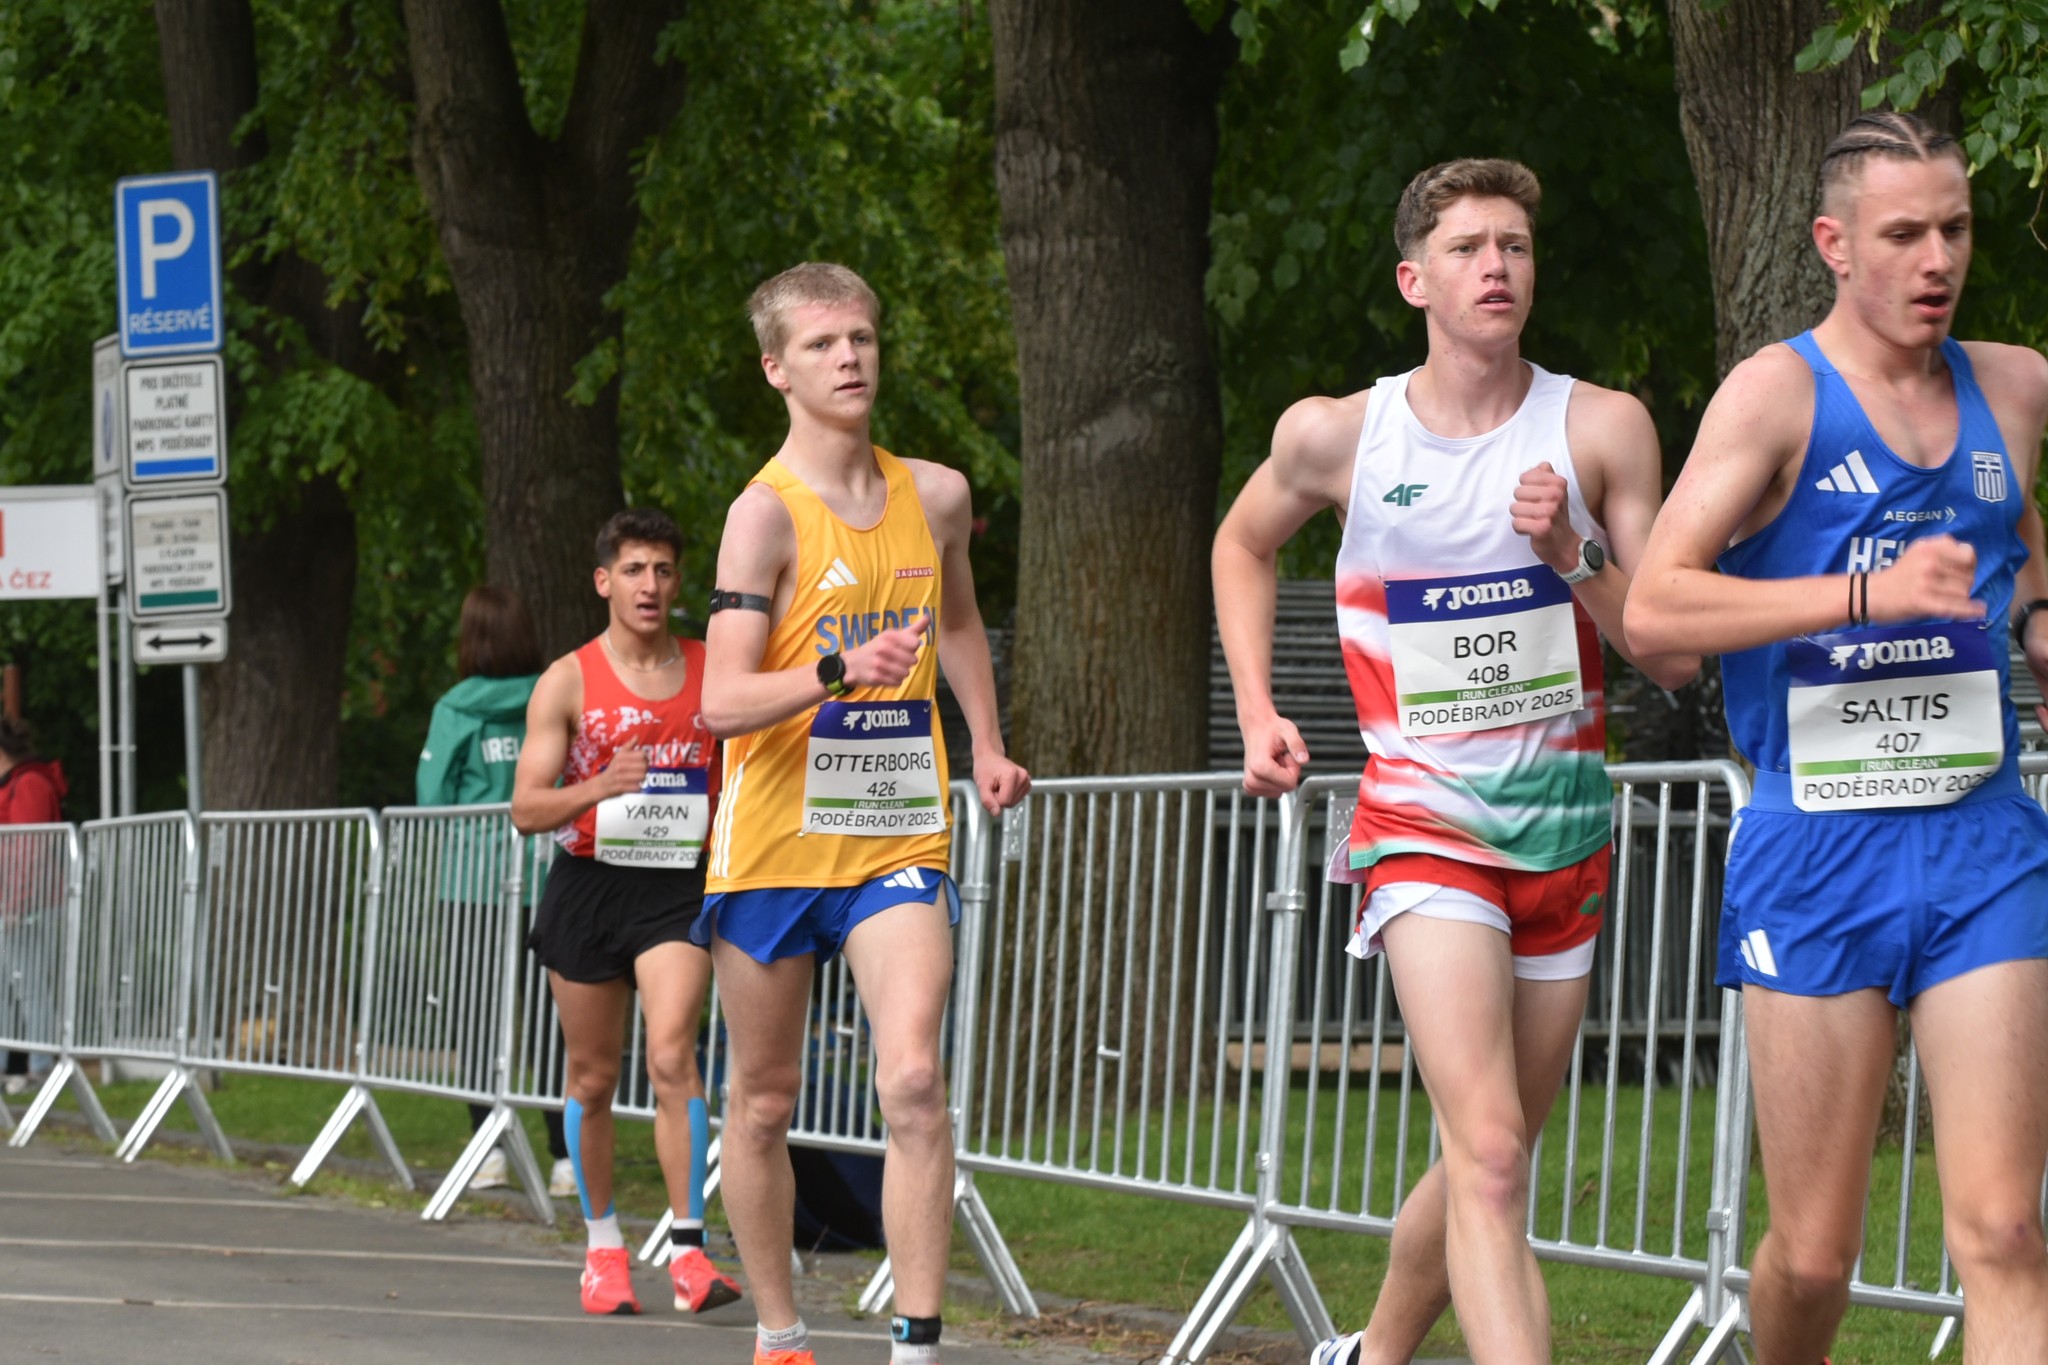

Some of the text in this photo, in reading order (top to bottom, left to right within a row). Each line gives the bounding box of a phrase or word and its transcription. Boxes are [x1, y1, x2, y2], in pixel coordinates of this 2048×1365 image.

[138, 197, 195, 299] P
[129, 301, 212, 336] RÉSERVÉ
[1382, 483, 1429, 506] 4F
[1883, 510, 1942, 522] AEGEAN
[9, 567, 52, 591] ČEZ
[895, 568, 933, 578] BAUHAUS
[1454, 630, 1517, 659] BOR
[1467, 664, 1509, 684] 408
[1462, 691, 1486, 700] RUN
[1409, 689, 1574, 726] PODĚBRADY 2025
[1841, 693, 1950, 724] SALTIS
[612, 738, 702, 767] RKİYE
[1876, 733, 1921, 753] 407
[814, 752, 931, 773] OTTERBORG
[1865, 759, 1895, 771] RUN
[866, 781, 897, 797] 426
[1804, 775, 1941, 800] PODĚBRADY
[625, 805, 690, 821] YARAN
[858, 801, 878, 810] RUN
[810, 810, 938, 828] PODĚBRADY 2025
[643, 826, 669, 839] 429
[600, 848, 700, 862] PODĚBRADY 202
